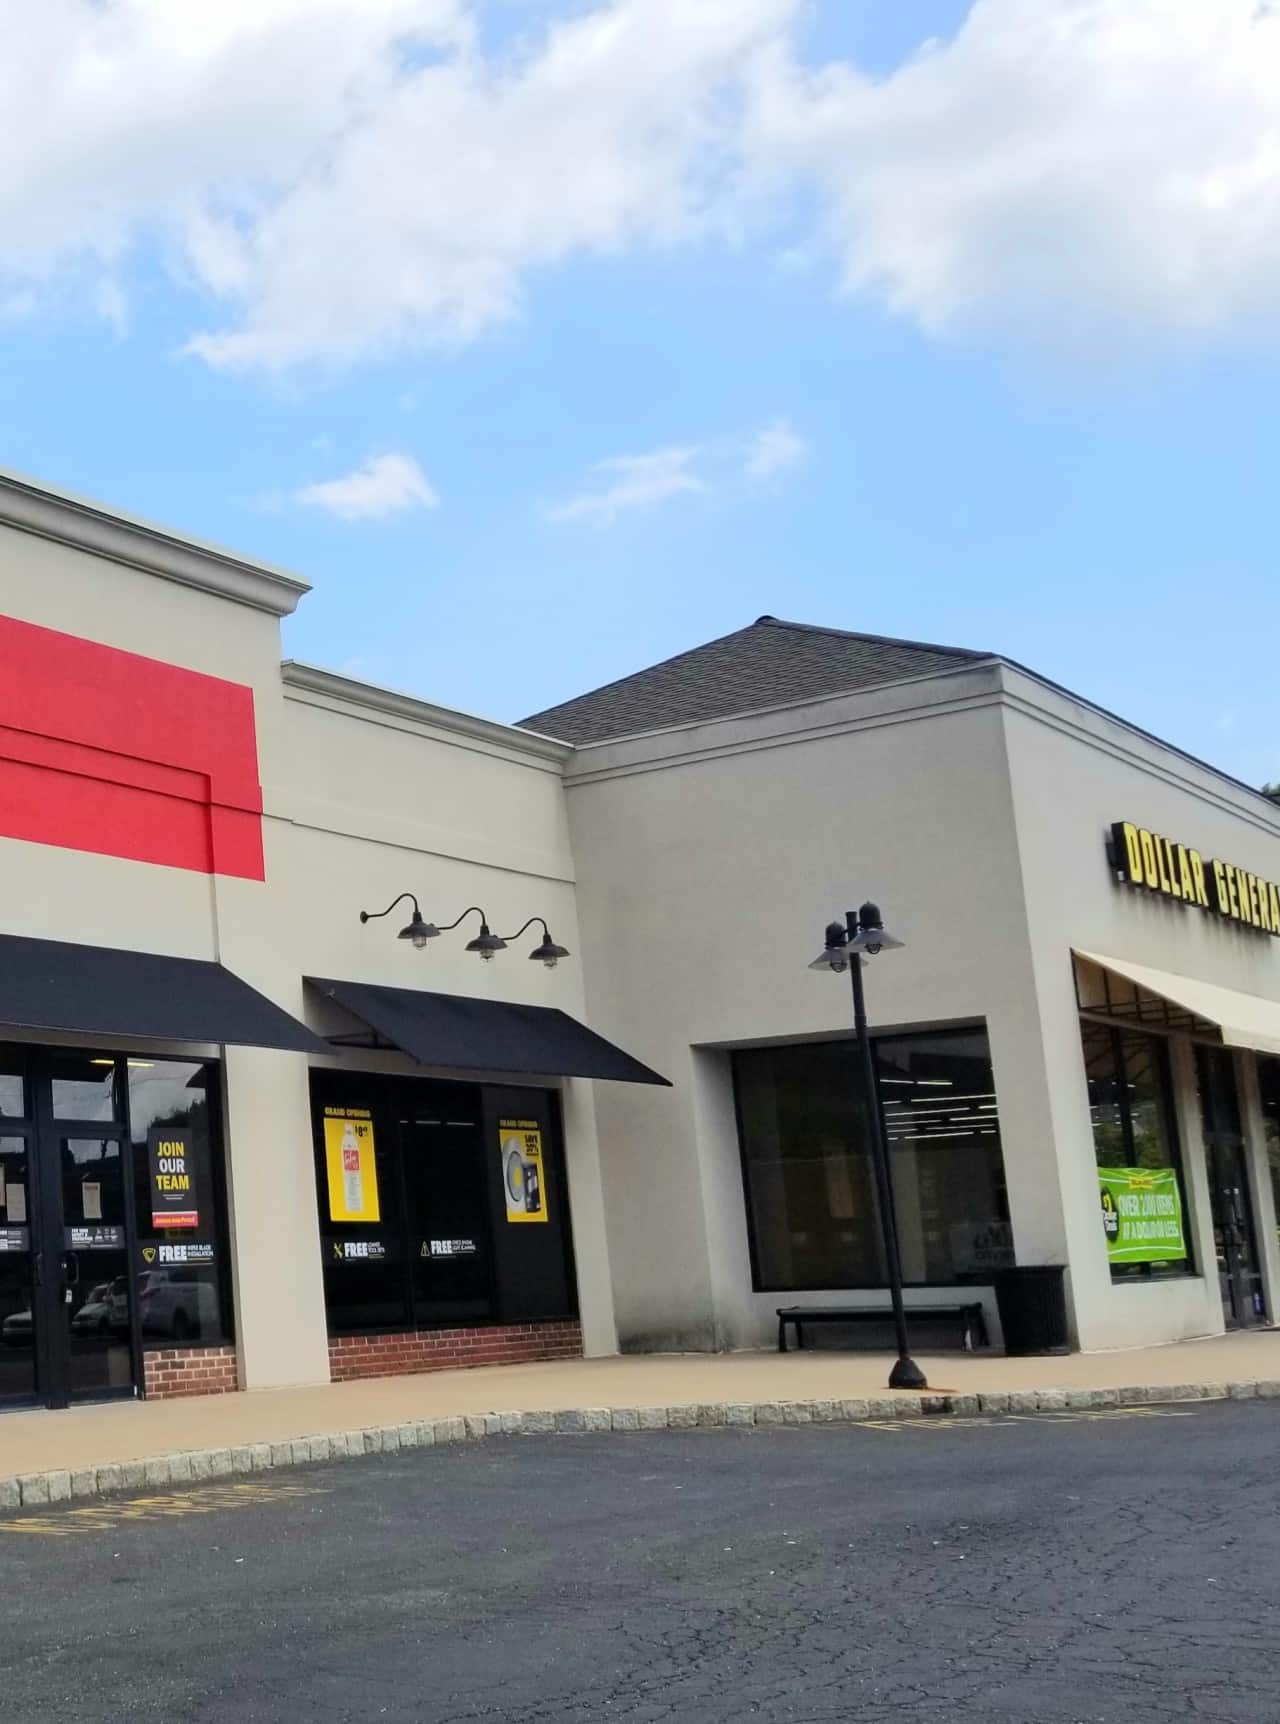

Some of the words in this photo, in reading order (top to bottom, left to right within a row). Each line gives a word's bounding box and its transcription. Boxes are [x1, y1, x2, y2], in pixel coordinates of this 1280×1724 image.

[1122, 821, 1209, 908] DOLLAR
[1212, 858, 1280, 936] GENERA
[157, 1141, 185, 1157] JOIN
[158, 1158, 186, 1174] OUR
[155, 1174, 190, 1191] TEAM
[158, 1245, 188, 1262] FREE
[344, 1242, 368, 1257] FREE
[430, 1240, 452, 1254] FREE
